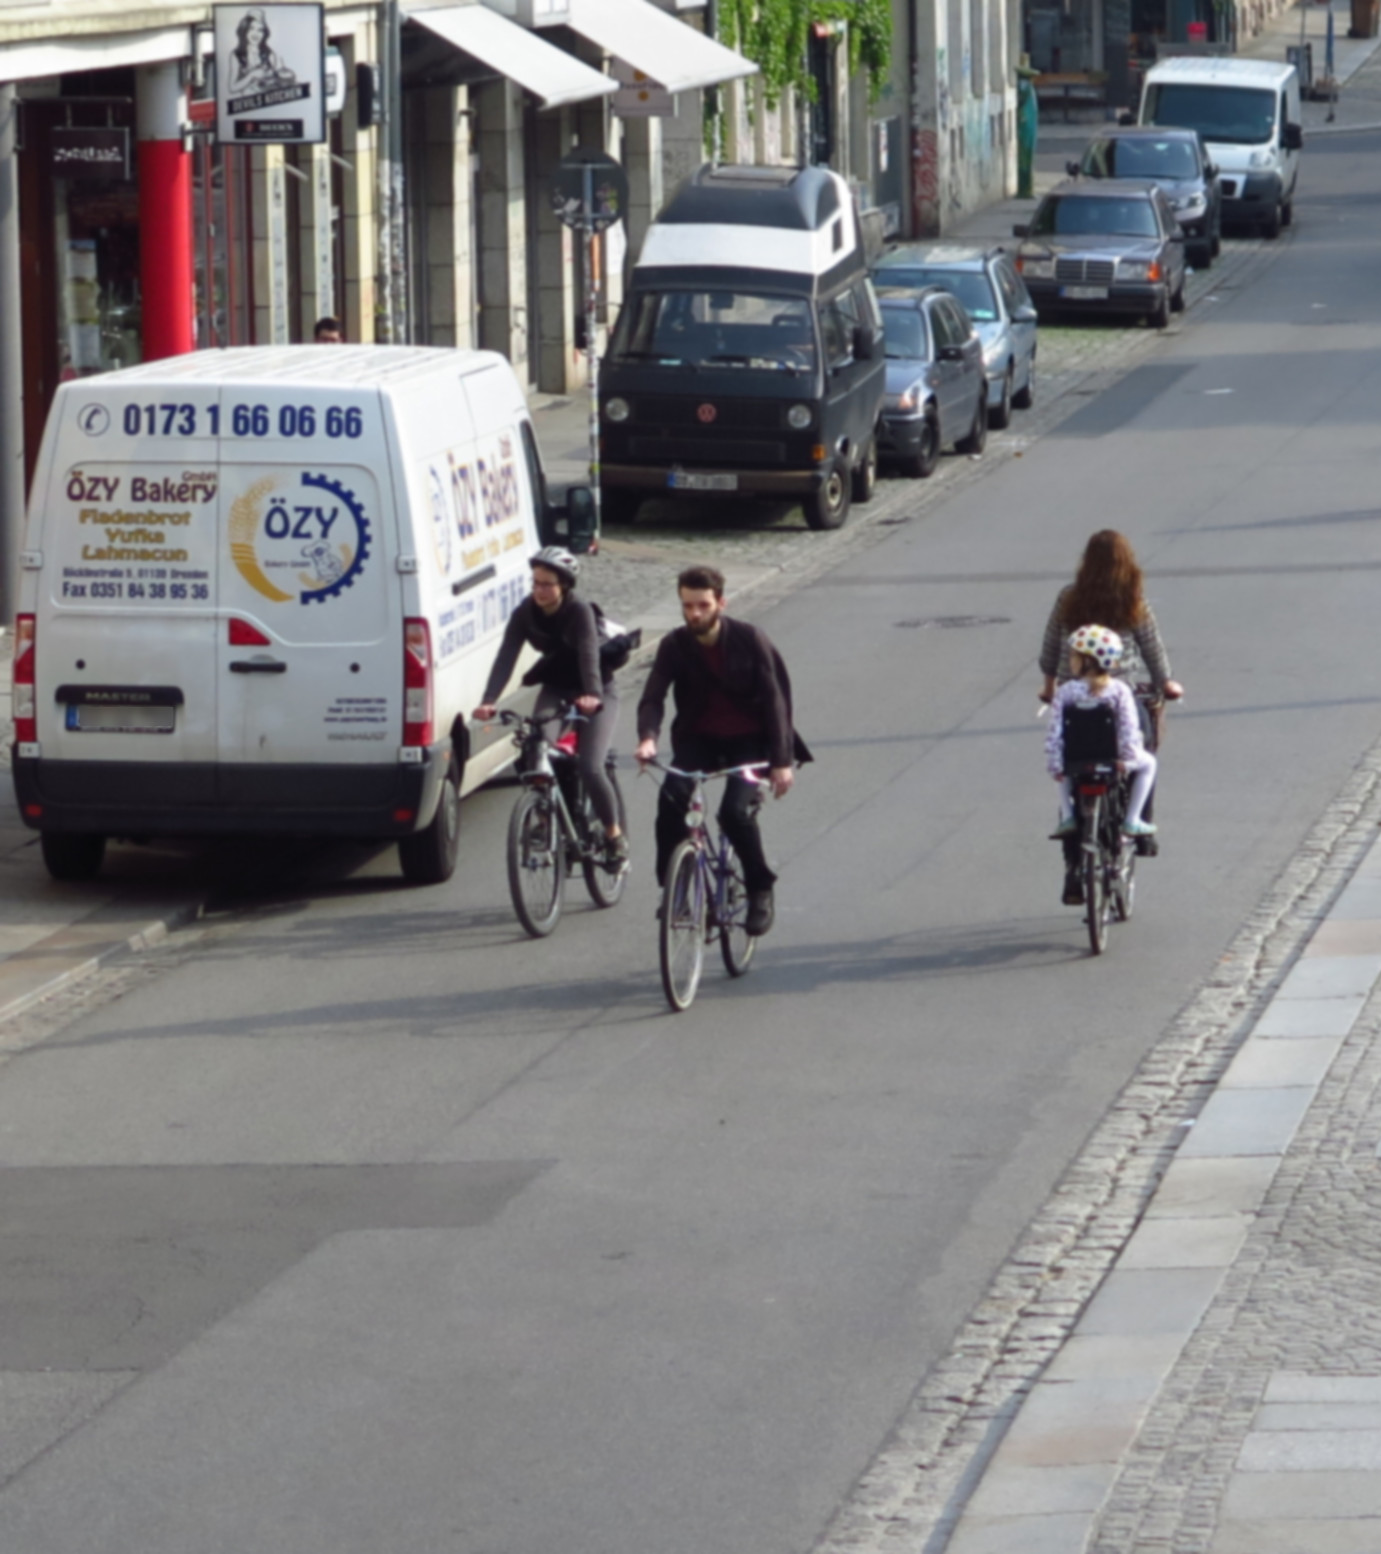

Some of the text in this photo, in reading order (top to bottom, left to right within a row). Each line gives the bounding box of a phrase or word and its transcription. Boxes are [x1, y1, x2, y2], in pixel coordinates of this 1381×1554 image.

[264, 86, 303, 105] KITCHEN
[123, 404, 363, 438] 0173 1 66 06 66
[67, 470, 217, 503] ÖZY Bakery
[79, 508, 191, 526] Fladenbrot
[264, 497, 338, 539] ÖZY
[105, 528, 166, 544] Yufka
[82, 544, 188, 561] Lahmacun
[62, 582, 209, 600] Fax 0351 84 38 95 36
[85, 692, 151, 701] MASTER
